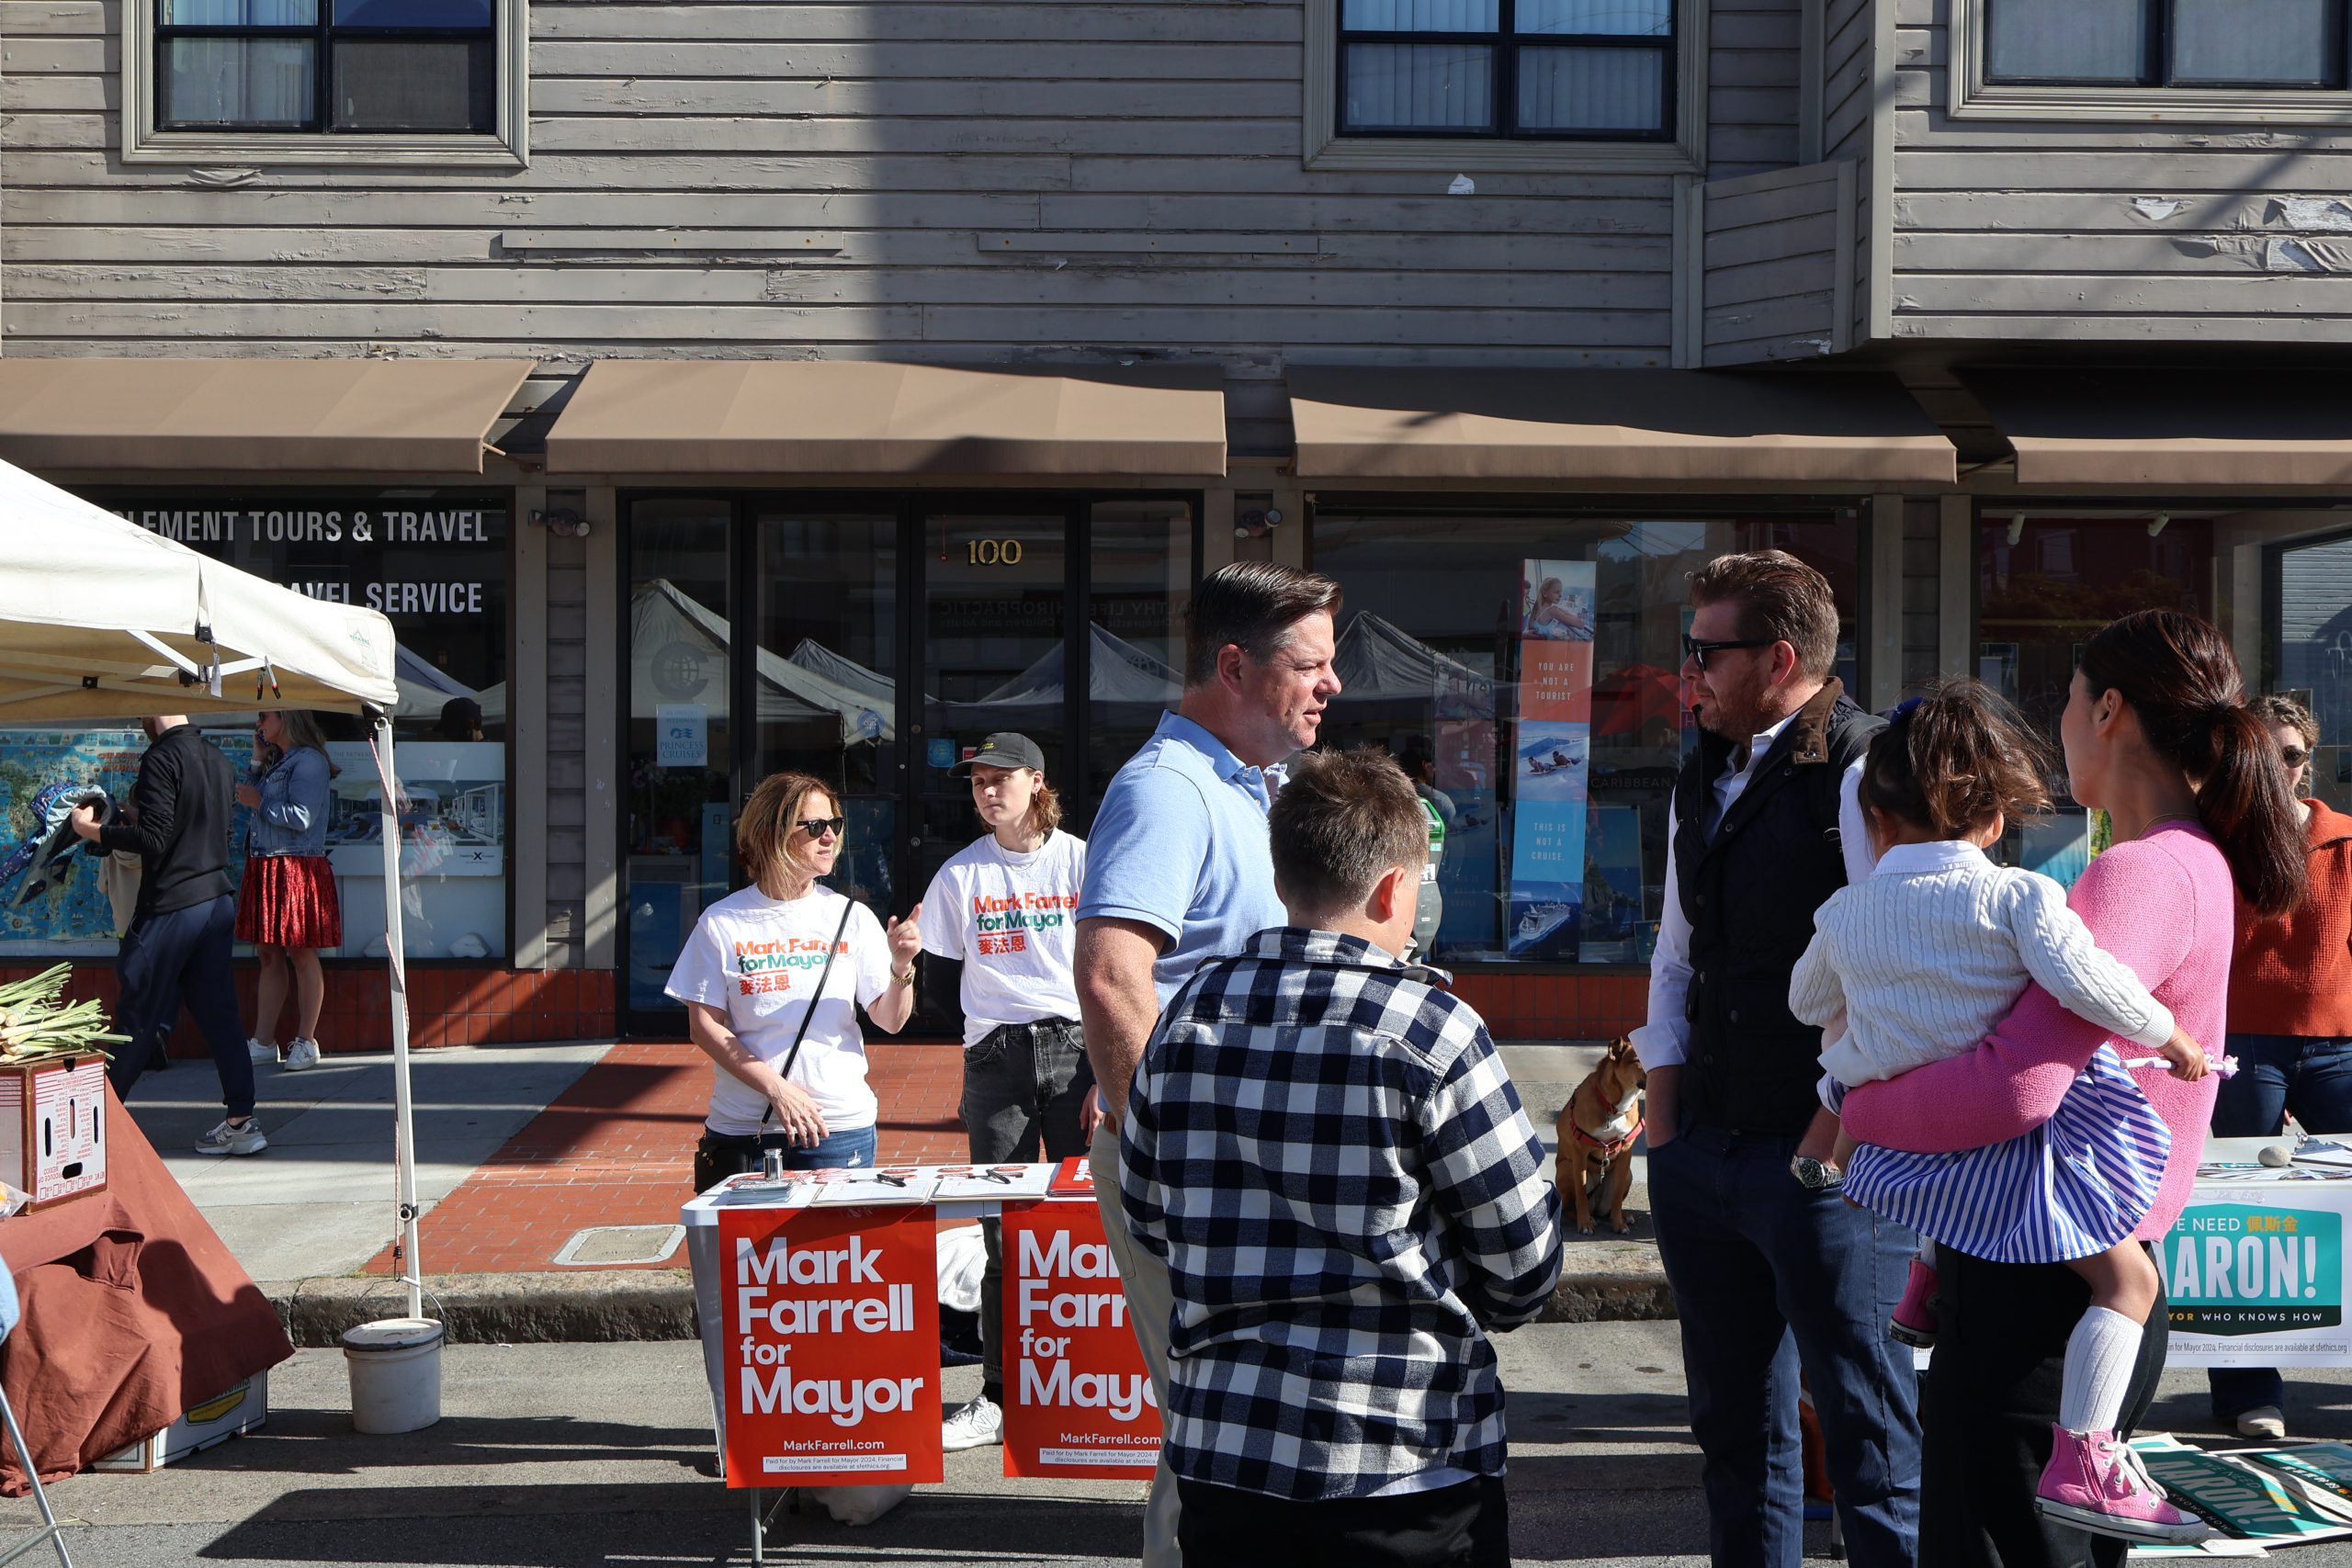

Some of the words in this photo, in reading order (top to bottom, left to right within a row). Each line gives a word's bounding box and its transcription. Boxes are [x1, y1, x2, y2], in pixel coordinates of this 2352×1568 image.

[248, 511, 343, 542] TOURS
[352, 511, 374, 542] &
[382, 511, 488, 542] TRAVEL
[967, 539, 1022, 564] 100
[366, 582, 482, 613] SERVICE
[1538, 661, 1555, 671] YOU
[1558, 662, 1575, 672] ARE
[1543, 676, 1558, 686] NOT
[1563, 677, 1569, 686] A
[1535, 691, 1575, 701] TOURIST.
[660, 741, 705, 750] PRINCESS
[662, 750, 701, 759] CRUISES
[1590, 778, 1671, 788] CARIBBEAN
[1534, 822, 1553, 832] THIS
[1557, 823, 1566, 832] IS
[1536, 837, 1552, 846] NOT
[1556, 837, 1563, 846] A
[1532, 852, 1565, 861] CRUISE.
[974, 893, 1023, 913] Mark
[1024, 892, 1080, 909] Farrel
[977, 914, 1003, 931] for
[1004, 910, 1065, 931] Mayor
[736, 939, 786, 955] Mark
[978, 935, 1026, 955] 麥法恩
[738, 954, 766, 973] for
[2193, 1218, 2241, 1231] NEED
[2246, 1215, 2299, 1233] 佩斯金
[736, 1235, 884, 1285] Mark
[738, 1284, 914, 1334] Farrell
[2202, 1313, 2232, 1321] WHO
[2239, 1313, 2286, 1321] KNOWS
[2293, 1313, 2323, 1321] HOW
[741, 1336, 792, 1365] for
[1020, 1328, 1070, 1358] for
[2175, 1343, 2183, 1351] for
[2184, 1343, 2201, 1353] Mayor
[2202, 1343, 2217, 1352] 2024.
[2218, 1342, 2243, 1351] Financial
[2244, 1342, 2274, 1352] disclosures
[2275, 1344, 2284, 1352] are
[2284, 1342, 2308, 1352] available
[2308, 1343, 2315, 1352] at
[2315, 1342, 2347, 1354] sfethics.org
[741, 1366, 924, 1427] Mayor
[784, 1438, 885, 1450] MarkFarrell.com
[1060, 1433, 1161, 1445] MarkFarrell.com
